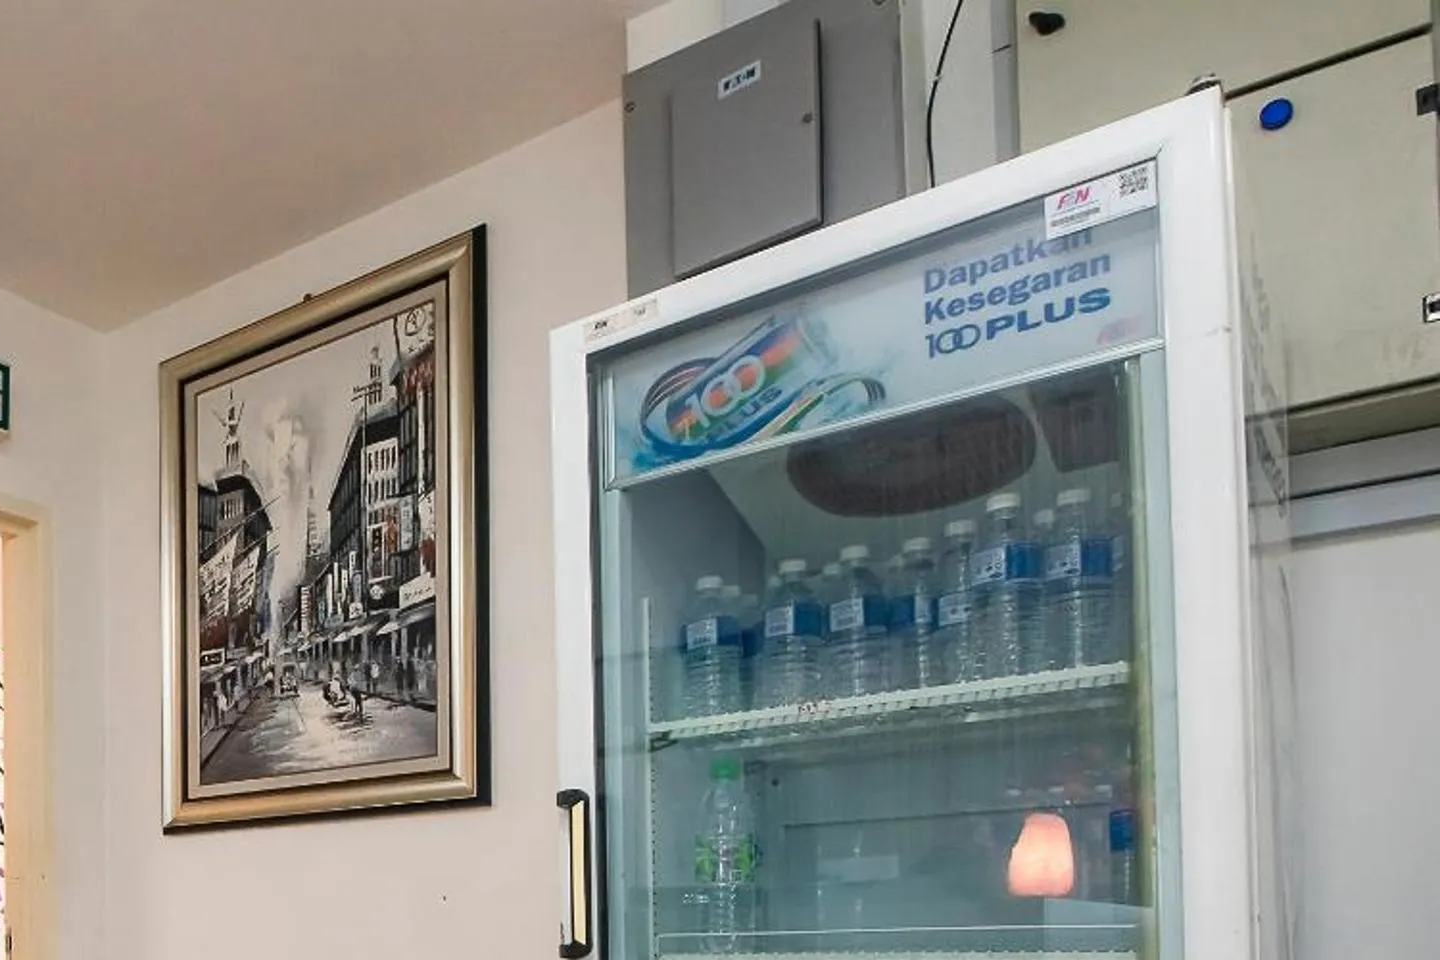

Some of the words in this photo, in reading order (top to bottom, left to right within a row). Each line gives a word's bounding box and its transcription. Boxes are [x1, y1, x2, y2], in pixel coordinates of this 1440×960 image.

[1057, 187, 1090, 210] FN
[924, 229, 1093, 294] Dapatkan
[924, 253, 1111, 325] Kesegaran
[684, 355, 766, 428] 100
